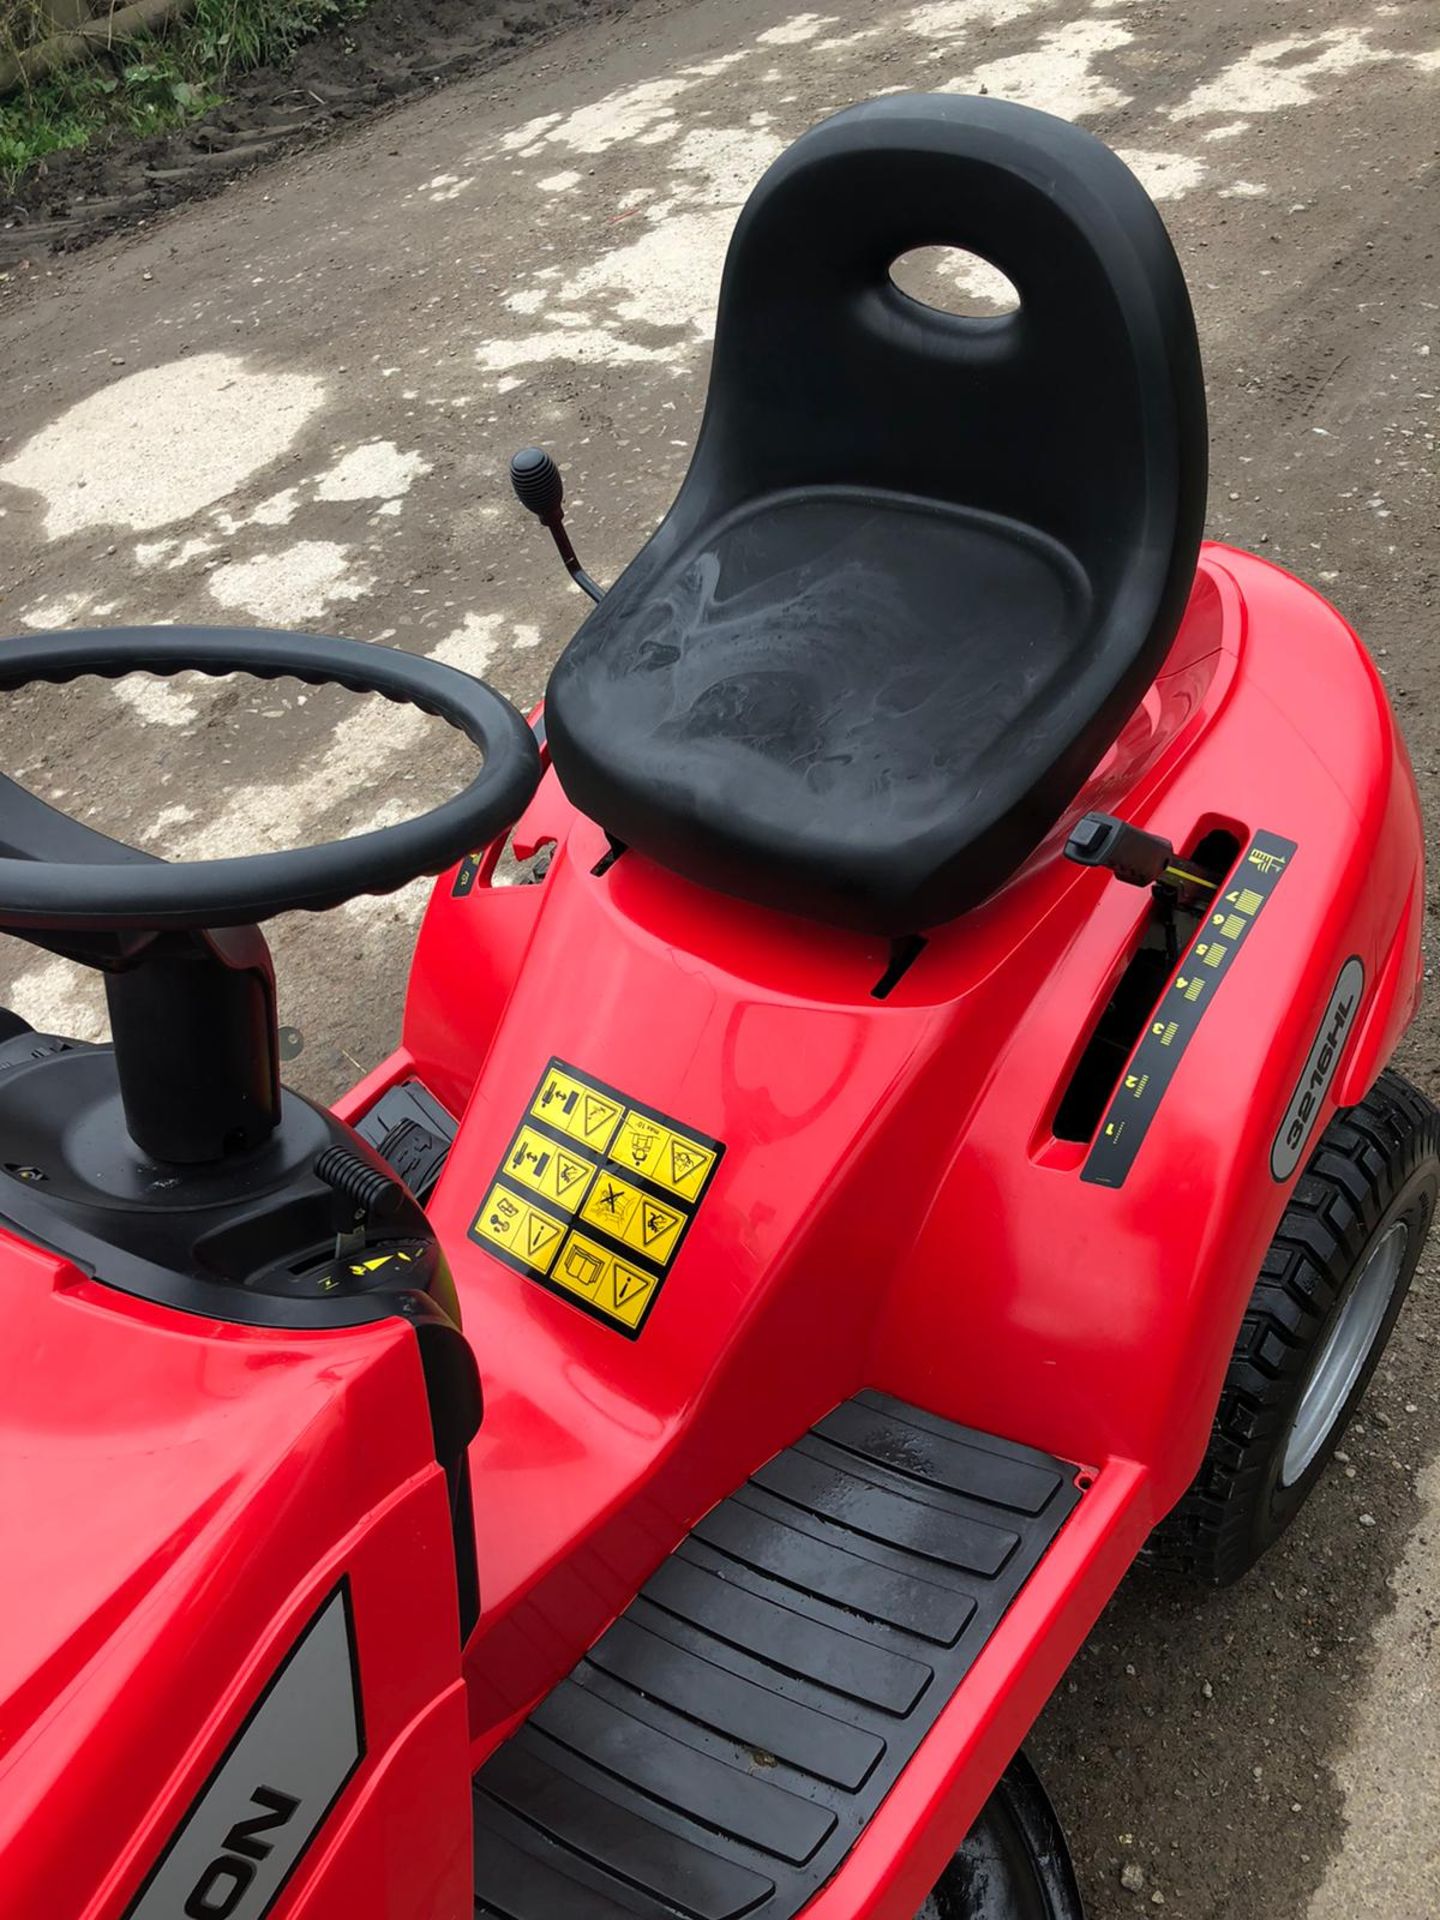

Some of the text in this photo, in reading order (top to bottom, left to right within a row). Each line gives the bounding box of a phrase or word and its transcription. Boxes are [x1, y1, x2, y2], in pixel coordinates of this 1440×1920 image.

[1226, 891, 1240, 902] 7
[1196, 943, 1209, 955] 5
[1175, 977, 1189, 989] 4
[1152, 1022, 1164, 1035] 3
[1286, 995, 1354, 1150] 3216HL
[1125, 1075, 1138, 1089] 2
[1106, 1123, 1115, 1136] 1
[184, 1784, 302, 1920] ON
